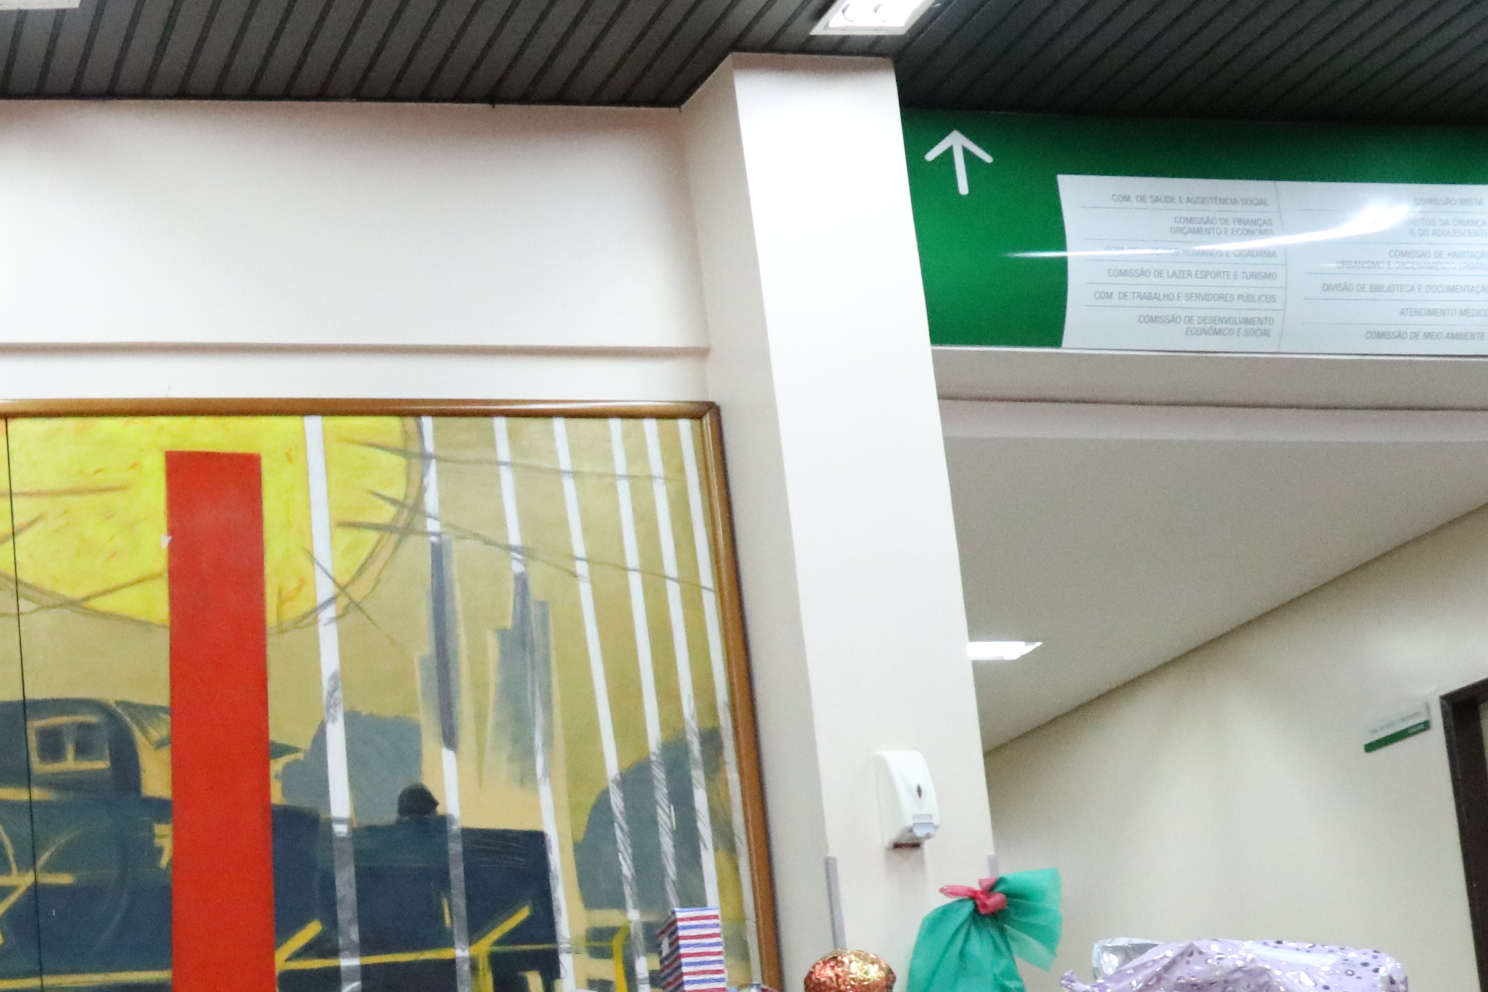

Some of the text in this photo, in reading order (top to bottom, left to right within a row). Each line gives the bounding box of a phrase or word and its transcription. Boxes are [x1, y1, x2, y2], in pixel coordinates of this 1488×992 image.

[1135, 194, 1147, 204] DE
[1149, 193, 1176, 204] SAÚDE
[1186, 194, 1239, 206] ASSISTÊNCIA
[1240, 196, 1269, 206] SOCIAL
[1174, 215, 1274, 228] COMISSÃO DE FINANÇAS
[1170, 225, 1274, 237] ORÇAMENTO E ECONOMIA
[1389, 248, 1432, 259] COMISSÃO
[1434, 250, 1445, 259] DE
[1107, 267, 1278, 281] COMISSÃO DE LAZER ESPORTE E TURISMO
[1322, 282, 1354, 293] DIVISÃO
[1356, 283, 1367, 293] DE
[1369, 283, 1416, 294] BIBLIOTECA
[1417, 284, 1423, 293] E
[1118, 291, 1129, 301] DE
[1131, 291, 1175, 302] TRABALHO
[1177, 292, 1182, 301] E
[1184, 292, 1235, 303] SERVIDORES
[1237, 291, 1277, 303] PÚBLICOS
[1399, 307, 1457, 317] ATENDIMENTO
[1138, 313, 1275, 326] COMISSÃO DE DESENVOLVIMENTO
[1185, 325, 1272, 338] ECONÔMICO E SOCIAL
[1365, 328, 1487, 341] COMISSÃO DE MEIO AMBIENTE
